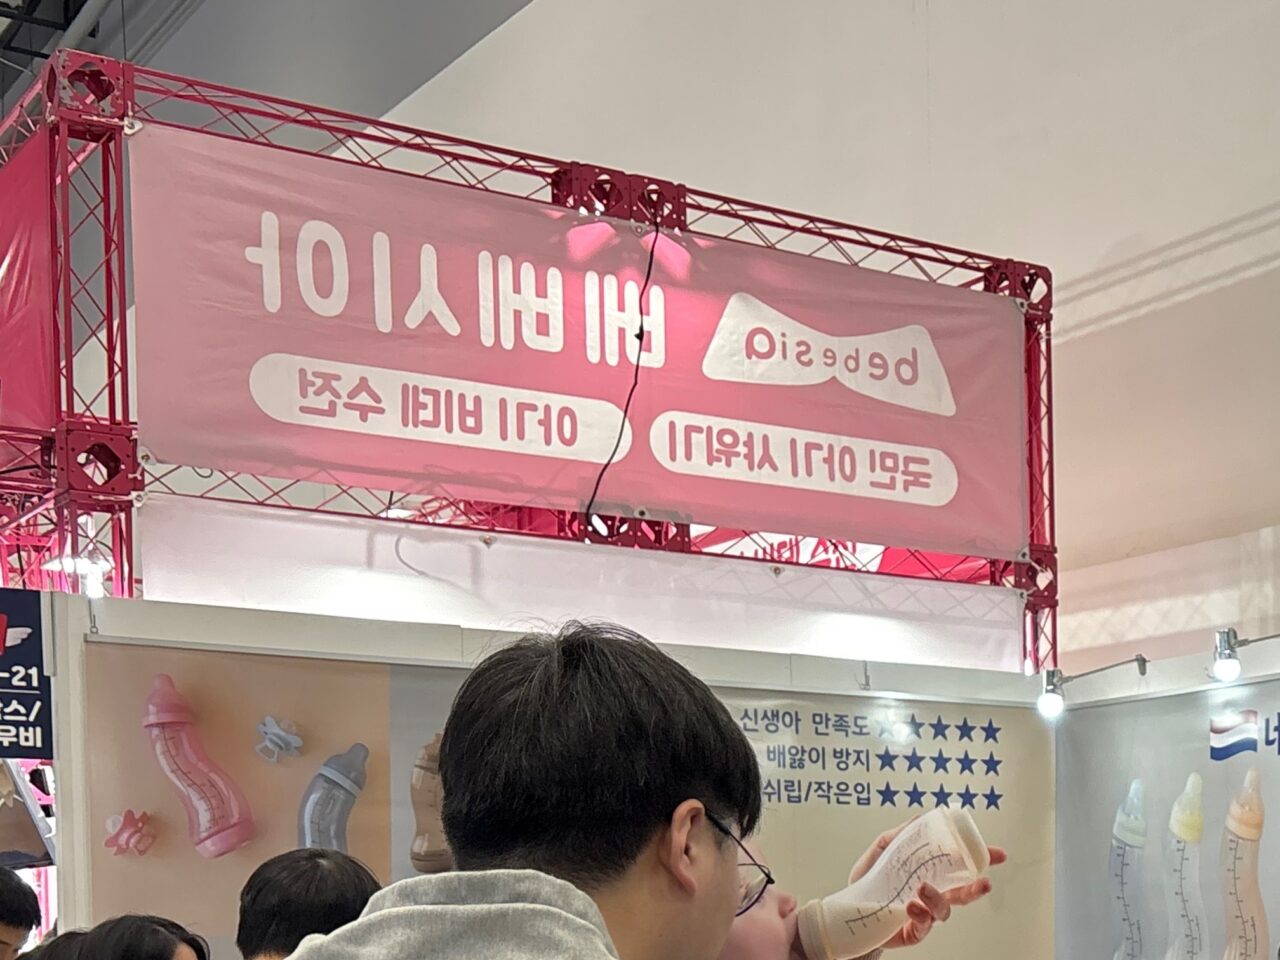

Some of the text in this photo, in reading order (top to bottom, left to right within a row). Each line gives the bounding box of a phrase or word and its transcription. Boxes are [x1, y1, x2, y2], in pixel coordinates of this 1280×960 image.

[0, 699, 42, 722] 스/
[740, 708, 870, 738] 신생아 만족도
[767, 744, 870, 772] 배앓이 방지
